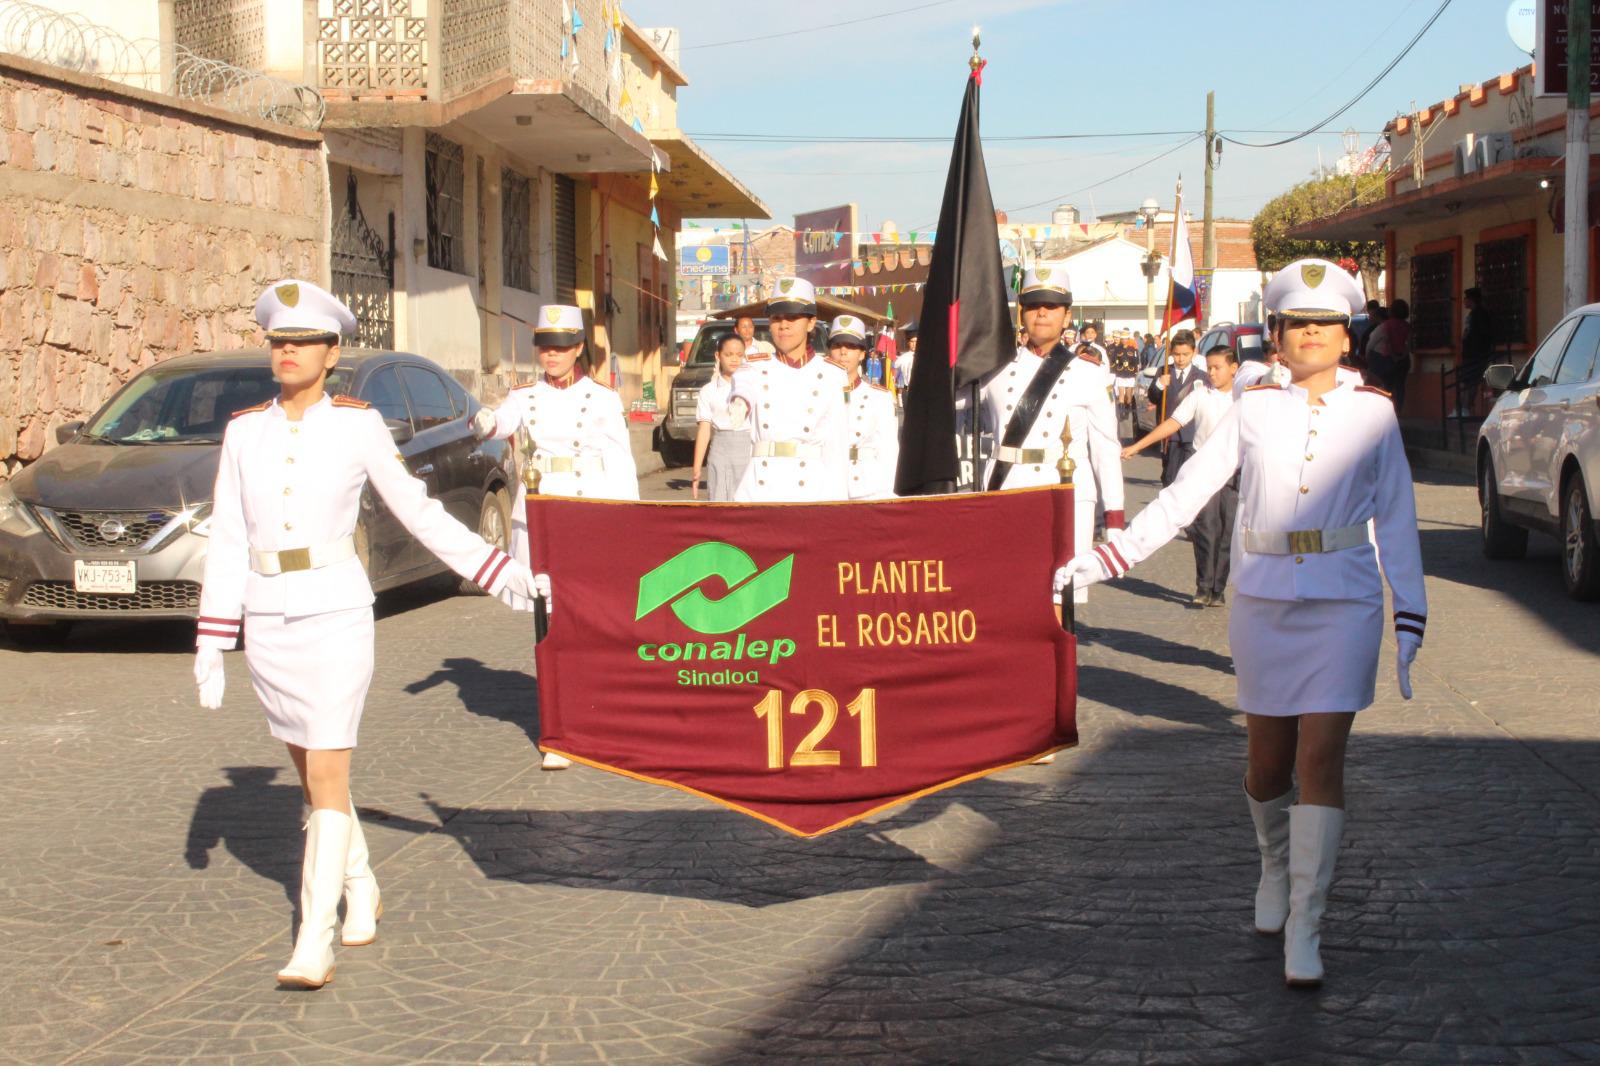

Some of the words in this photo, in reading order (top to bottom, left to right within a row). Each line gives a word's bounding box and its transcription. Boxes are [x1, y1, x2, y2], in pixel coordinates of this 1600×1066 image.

[77, 568, 133, 583] VKJ-753-A
[838, 560, 951, 594] PLANTEL
[817, 614, 845, 647] EL
[857, 609, 976, 647] ROSARIO
[637, 634, 796, 664] conalep
[677, 669, 759, 686] Sinaloa
[753, 688, 877, 768] 121
